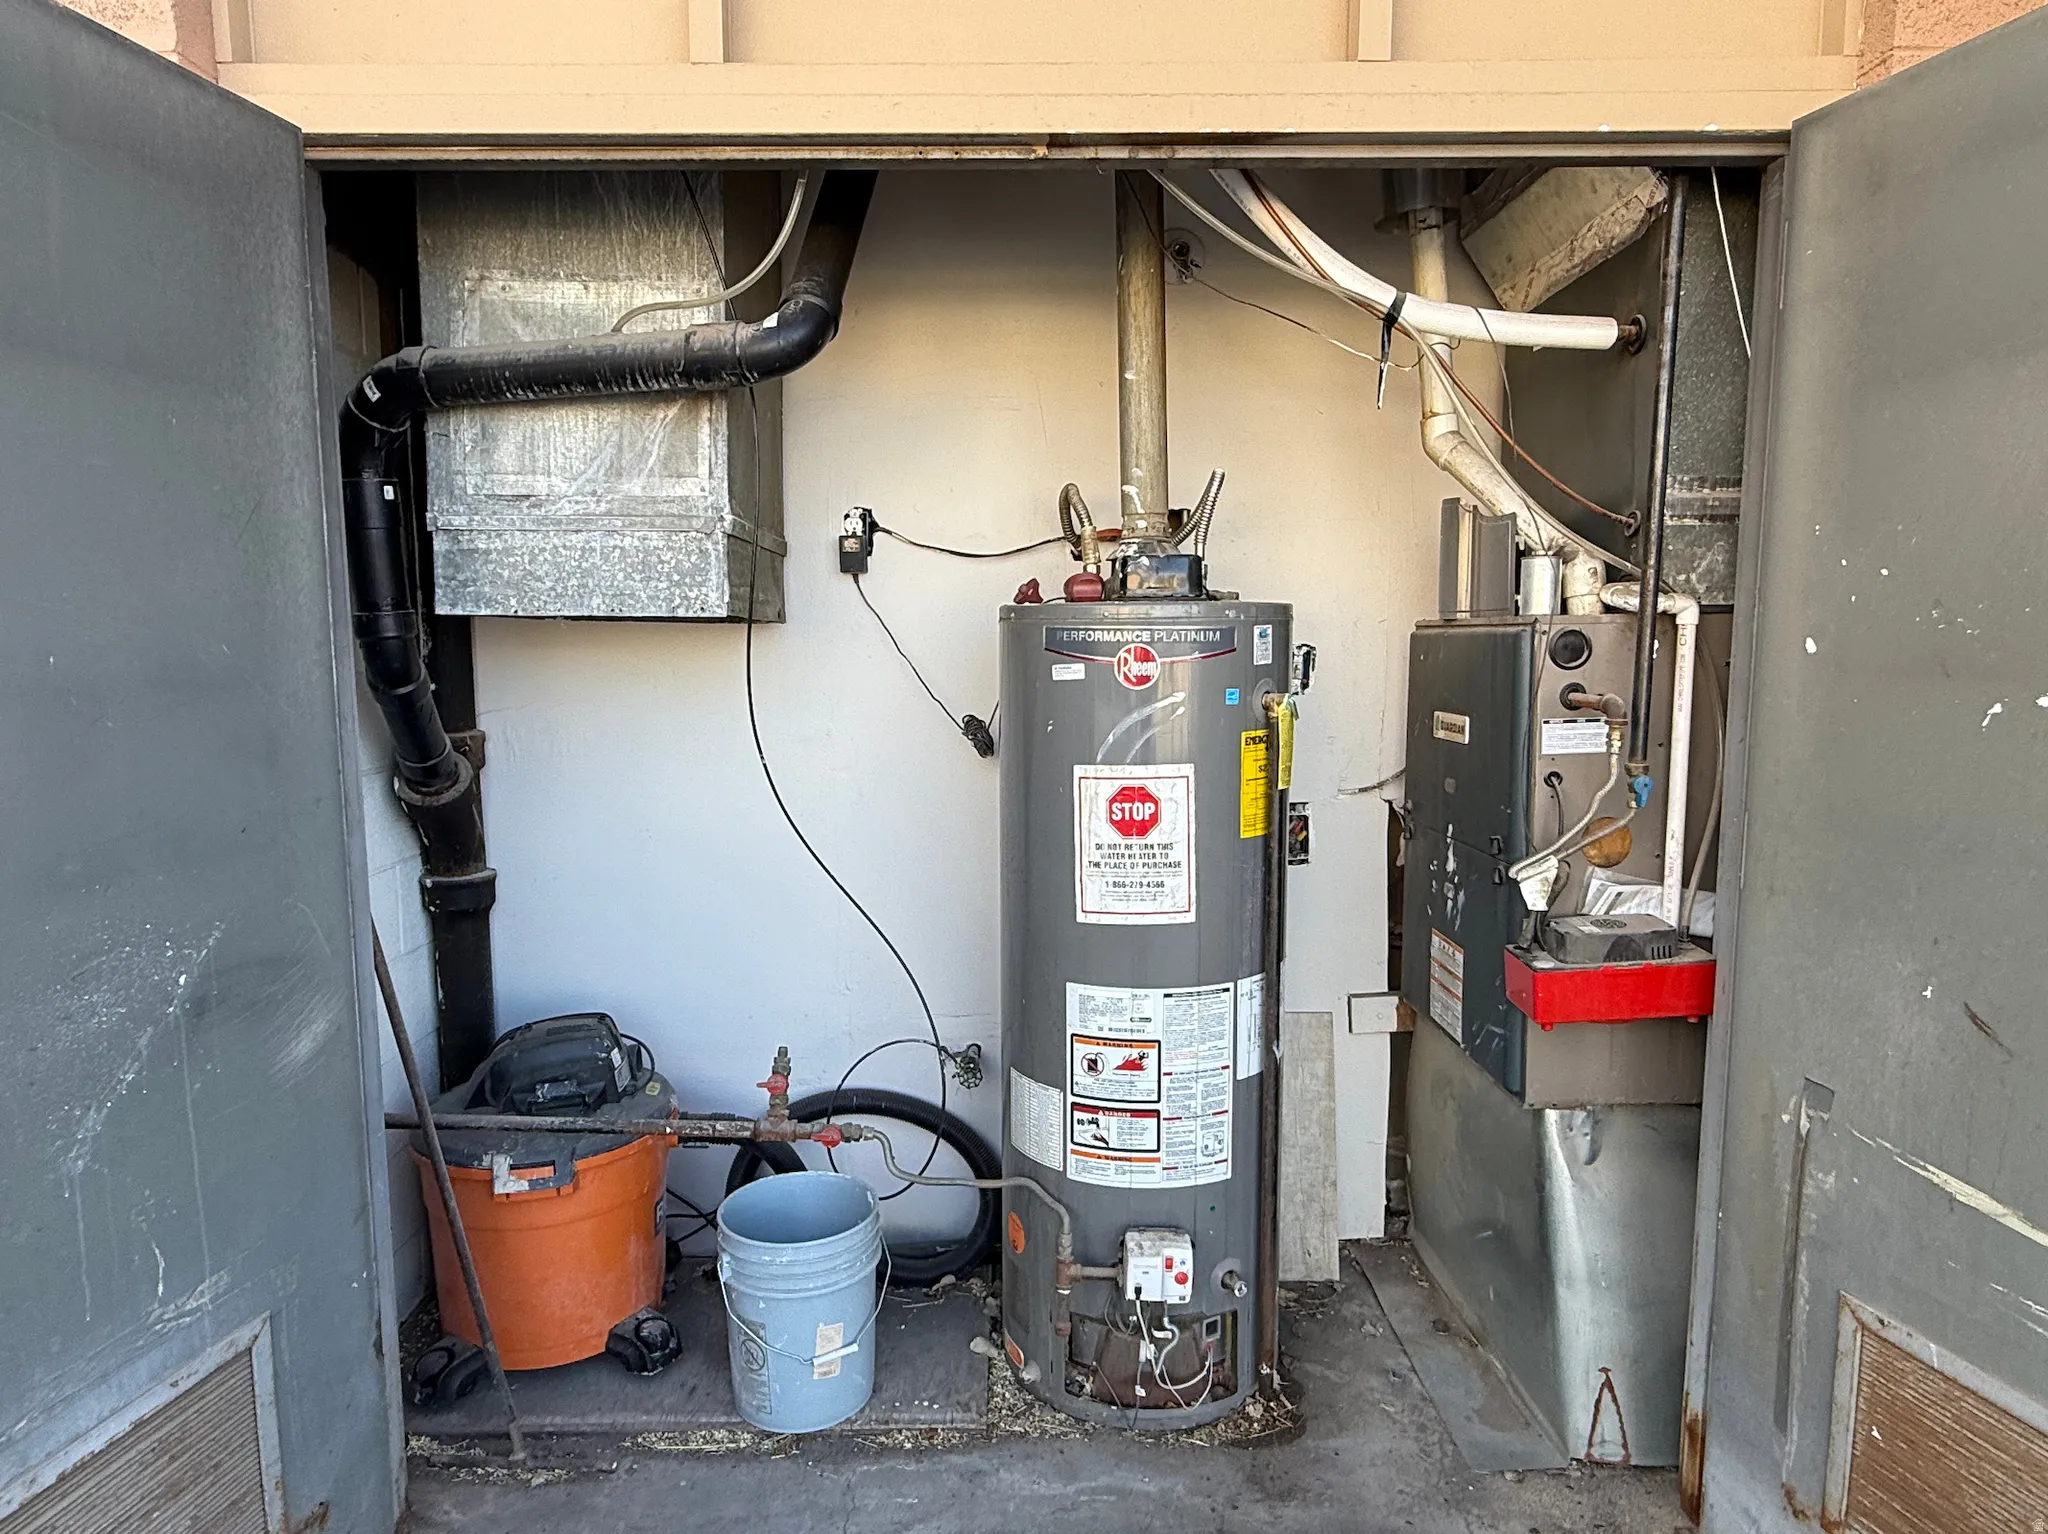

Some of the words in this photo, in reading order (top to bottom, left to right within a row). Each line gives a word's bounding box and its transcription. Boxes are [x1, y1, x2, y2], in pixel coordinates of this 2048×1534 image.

[1056, 630, 1151, 642] PERFORMANCE
[1154, 630, 1221, 642] PLATINUM
[1119, 645, 1157, 683] Rheem
[1111, 801, 1156, 821] STOP
[1095, 843, 1106, 851] DO
[1107, 843, 1121, 851] NOT
[1124, 843, 1155, 851] RETURN
[1157, 842, 1174, 850] THIS
[1100, 852, 1126, 860] WATER
[1128, 852, 1157, 860] HEATER
[1159, 852, 1169, 860] TO
[1088, 860, 1101, 869] THE
[1104, 861, 1128, 870] PLACE
[1130, 861, 1140, 869] OF
[1142, 861, 1182, 869] PURCHASE
